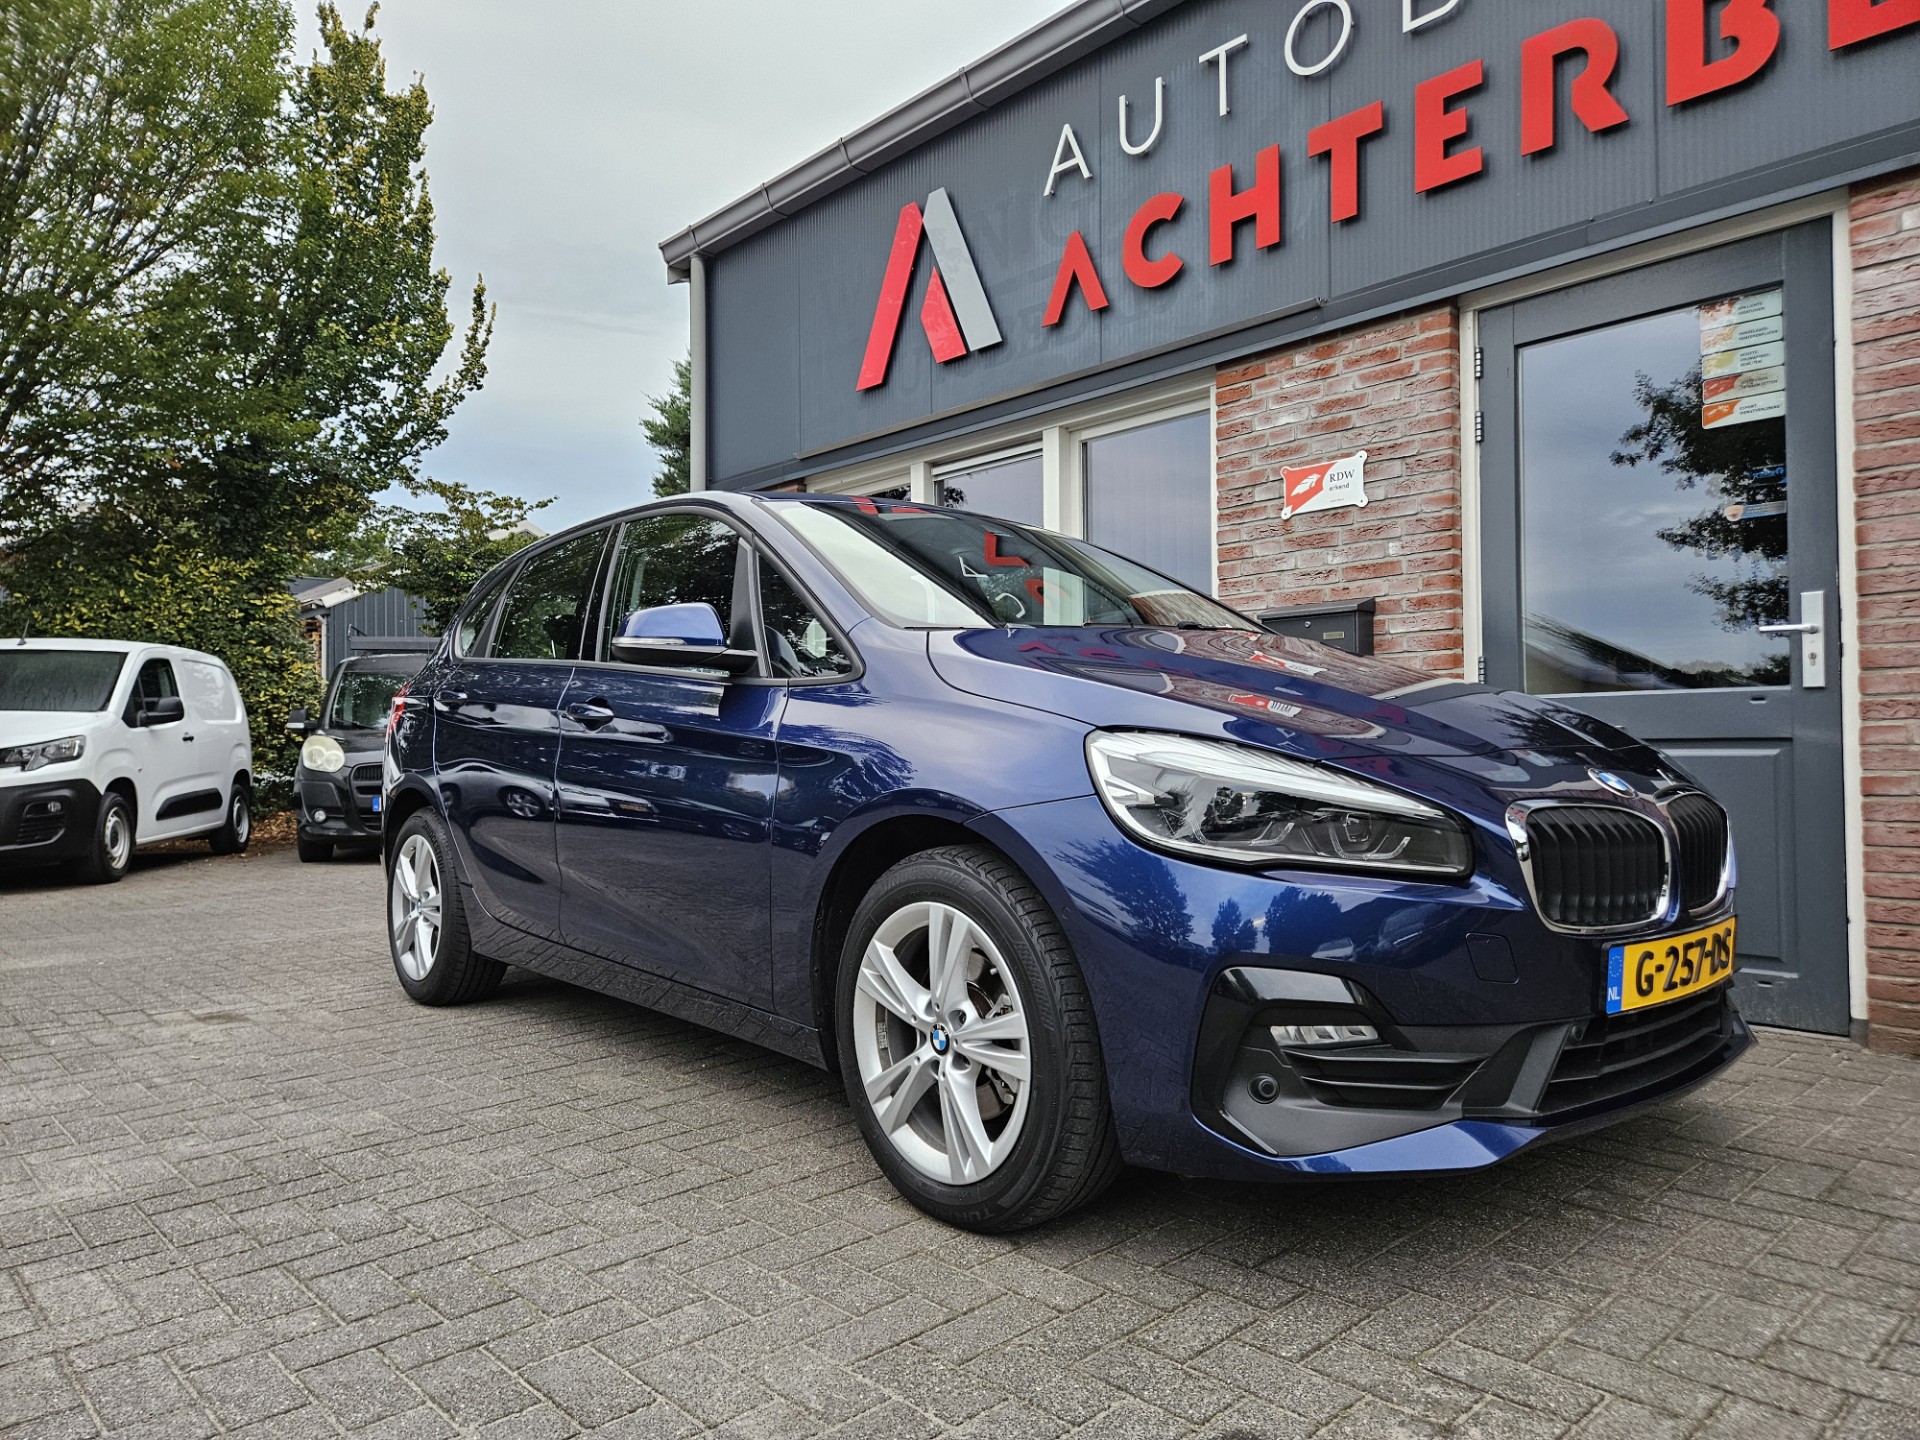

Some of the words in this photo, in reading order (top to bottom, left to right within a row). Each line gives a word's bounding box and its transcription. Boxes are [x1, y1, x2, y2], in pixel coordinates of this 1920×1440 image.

[1329, 469, 1355, 483] RDW
[1329, 483, 1350, 491] erkend
[1636, 927, 1732, 997] G-257-DS
[1608, 986, 1620, 1001] NL
